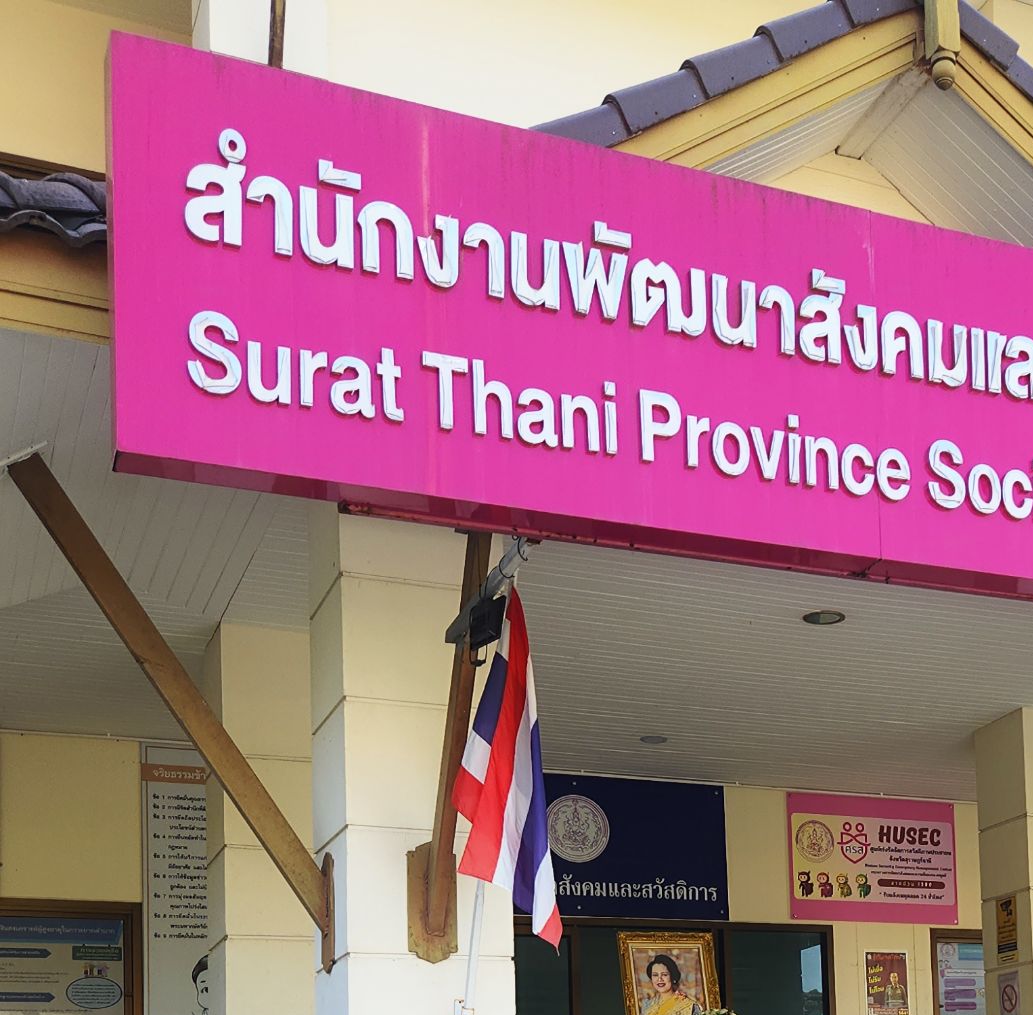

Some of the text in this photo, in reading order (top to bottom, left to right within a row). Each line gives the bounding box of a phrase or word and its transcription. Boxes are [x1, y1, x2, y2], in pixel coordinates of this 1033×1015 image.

[187, 310, 405, 422] Surat
[422, 350, 618, 455] Thani
[639, 388, 911, 502] Province
[878, 825, 941, 847] HUSEC
